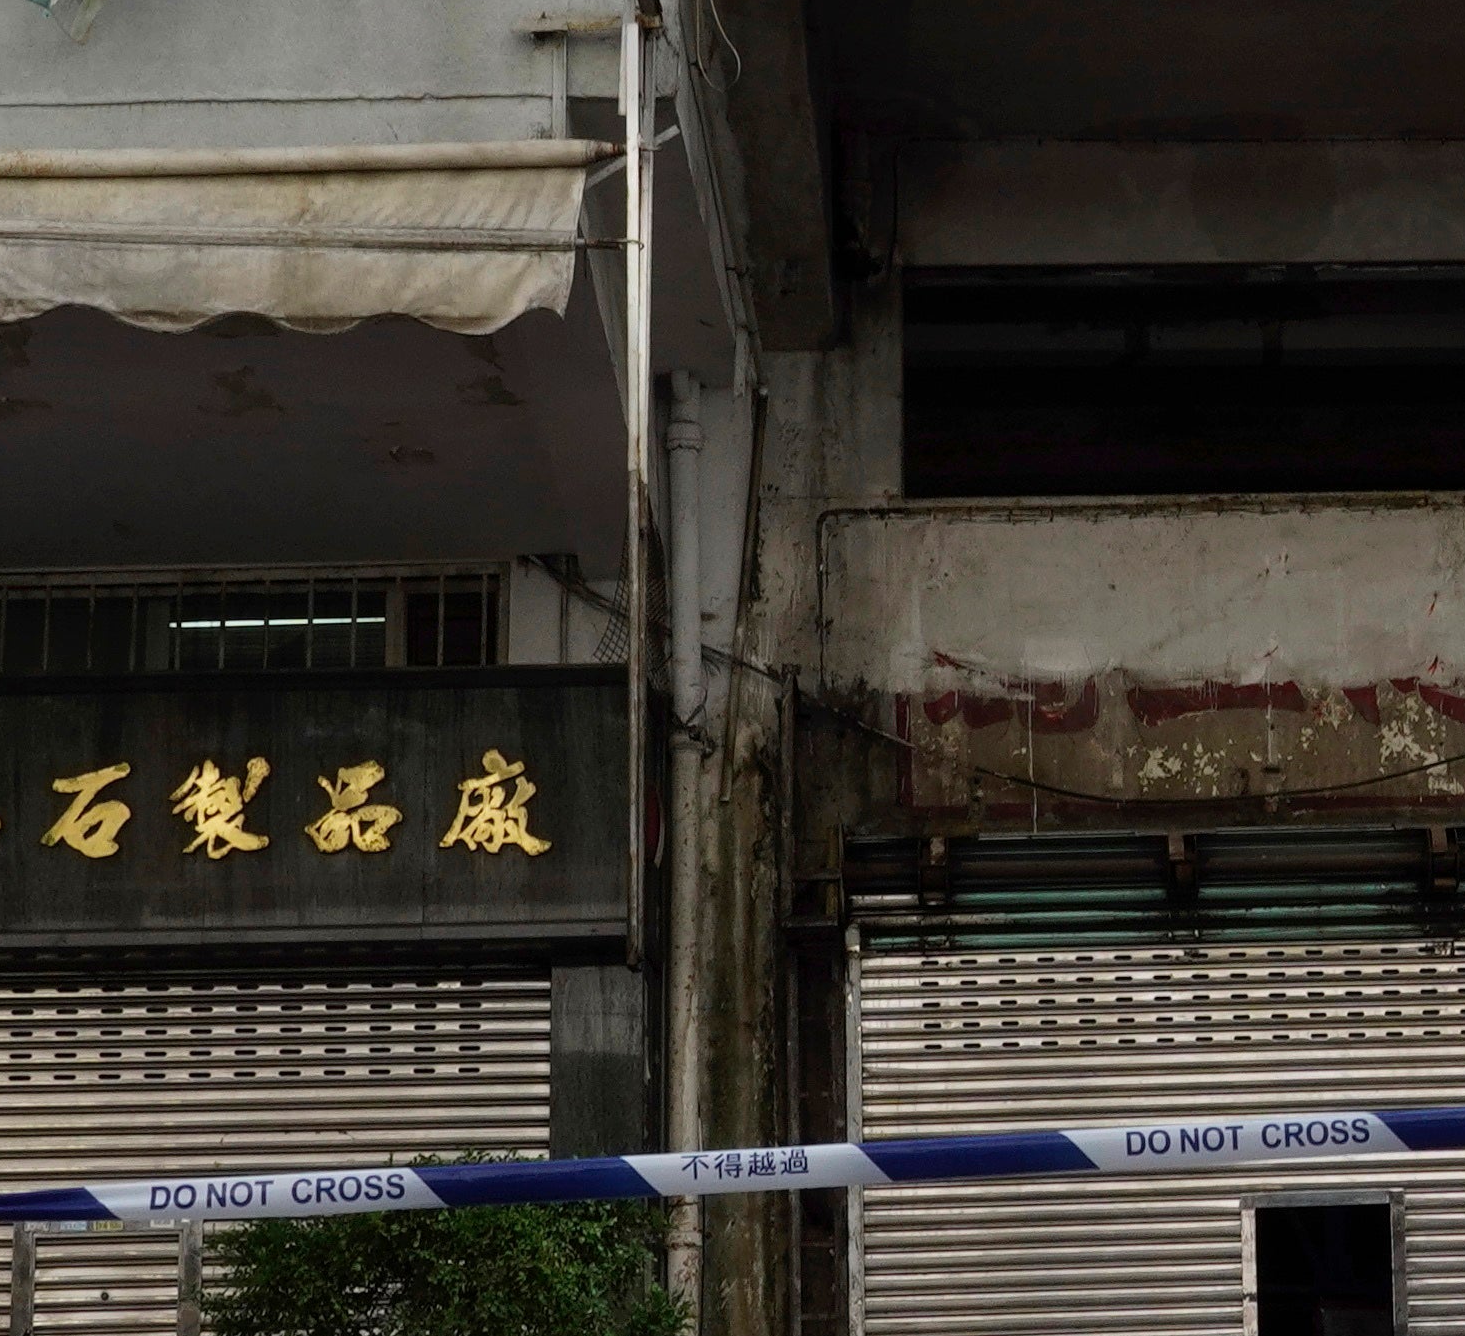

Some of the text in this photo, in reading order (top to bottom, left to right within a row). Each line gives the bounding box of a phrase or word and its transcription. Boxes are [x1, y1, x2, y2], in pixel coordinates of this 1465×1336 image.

[1126, 1119, 1371, 1156] DO NOT CROSS
[681, 1149, 810, 1180] 不得越過
[149, 1174, 406, 1210] DO NOT CROSS
